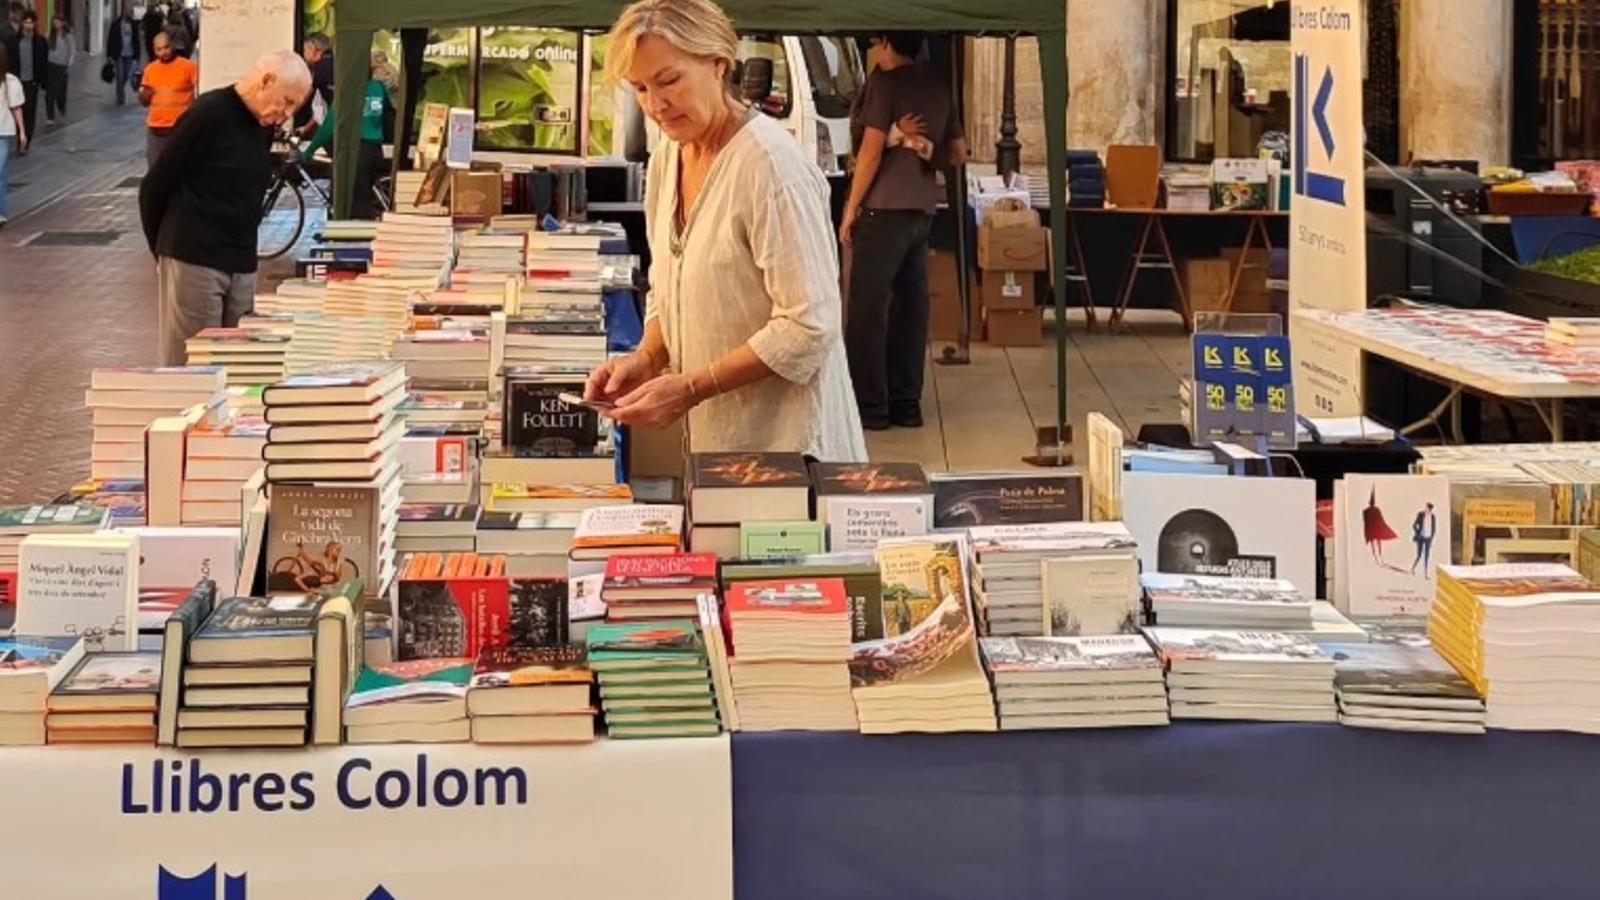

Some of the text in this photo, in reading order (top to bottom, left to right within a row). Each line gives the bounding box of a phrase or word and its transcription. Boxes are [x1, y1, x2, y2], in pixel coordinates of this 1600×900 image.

[540, 399, 570, 413] KEN
[523, 411, 586, 429] FOLLETT
[98, 565, 124, 576] Vidal
[122, 753, 529, 815] Llibres Colom
